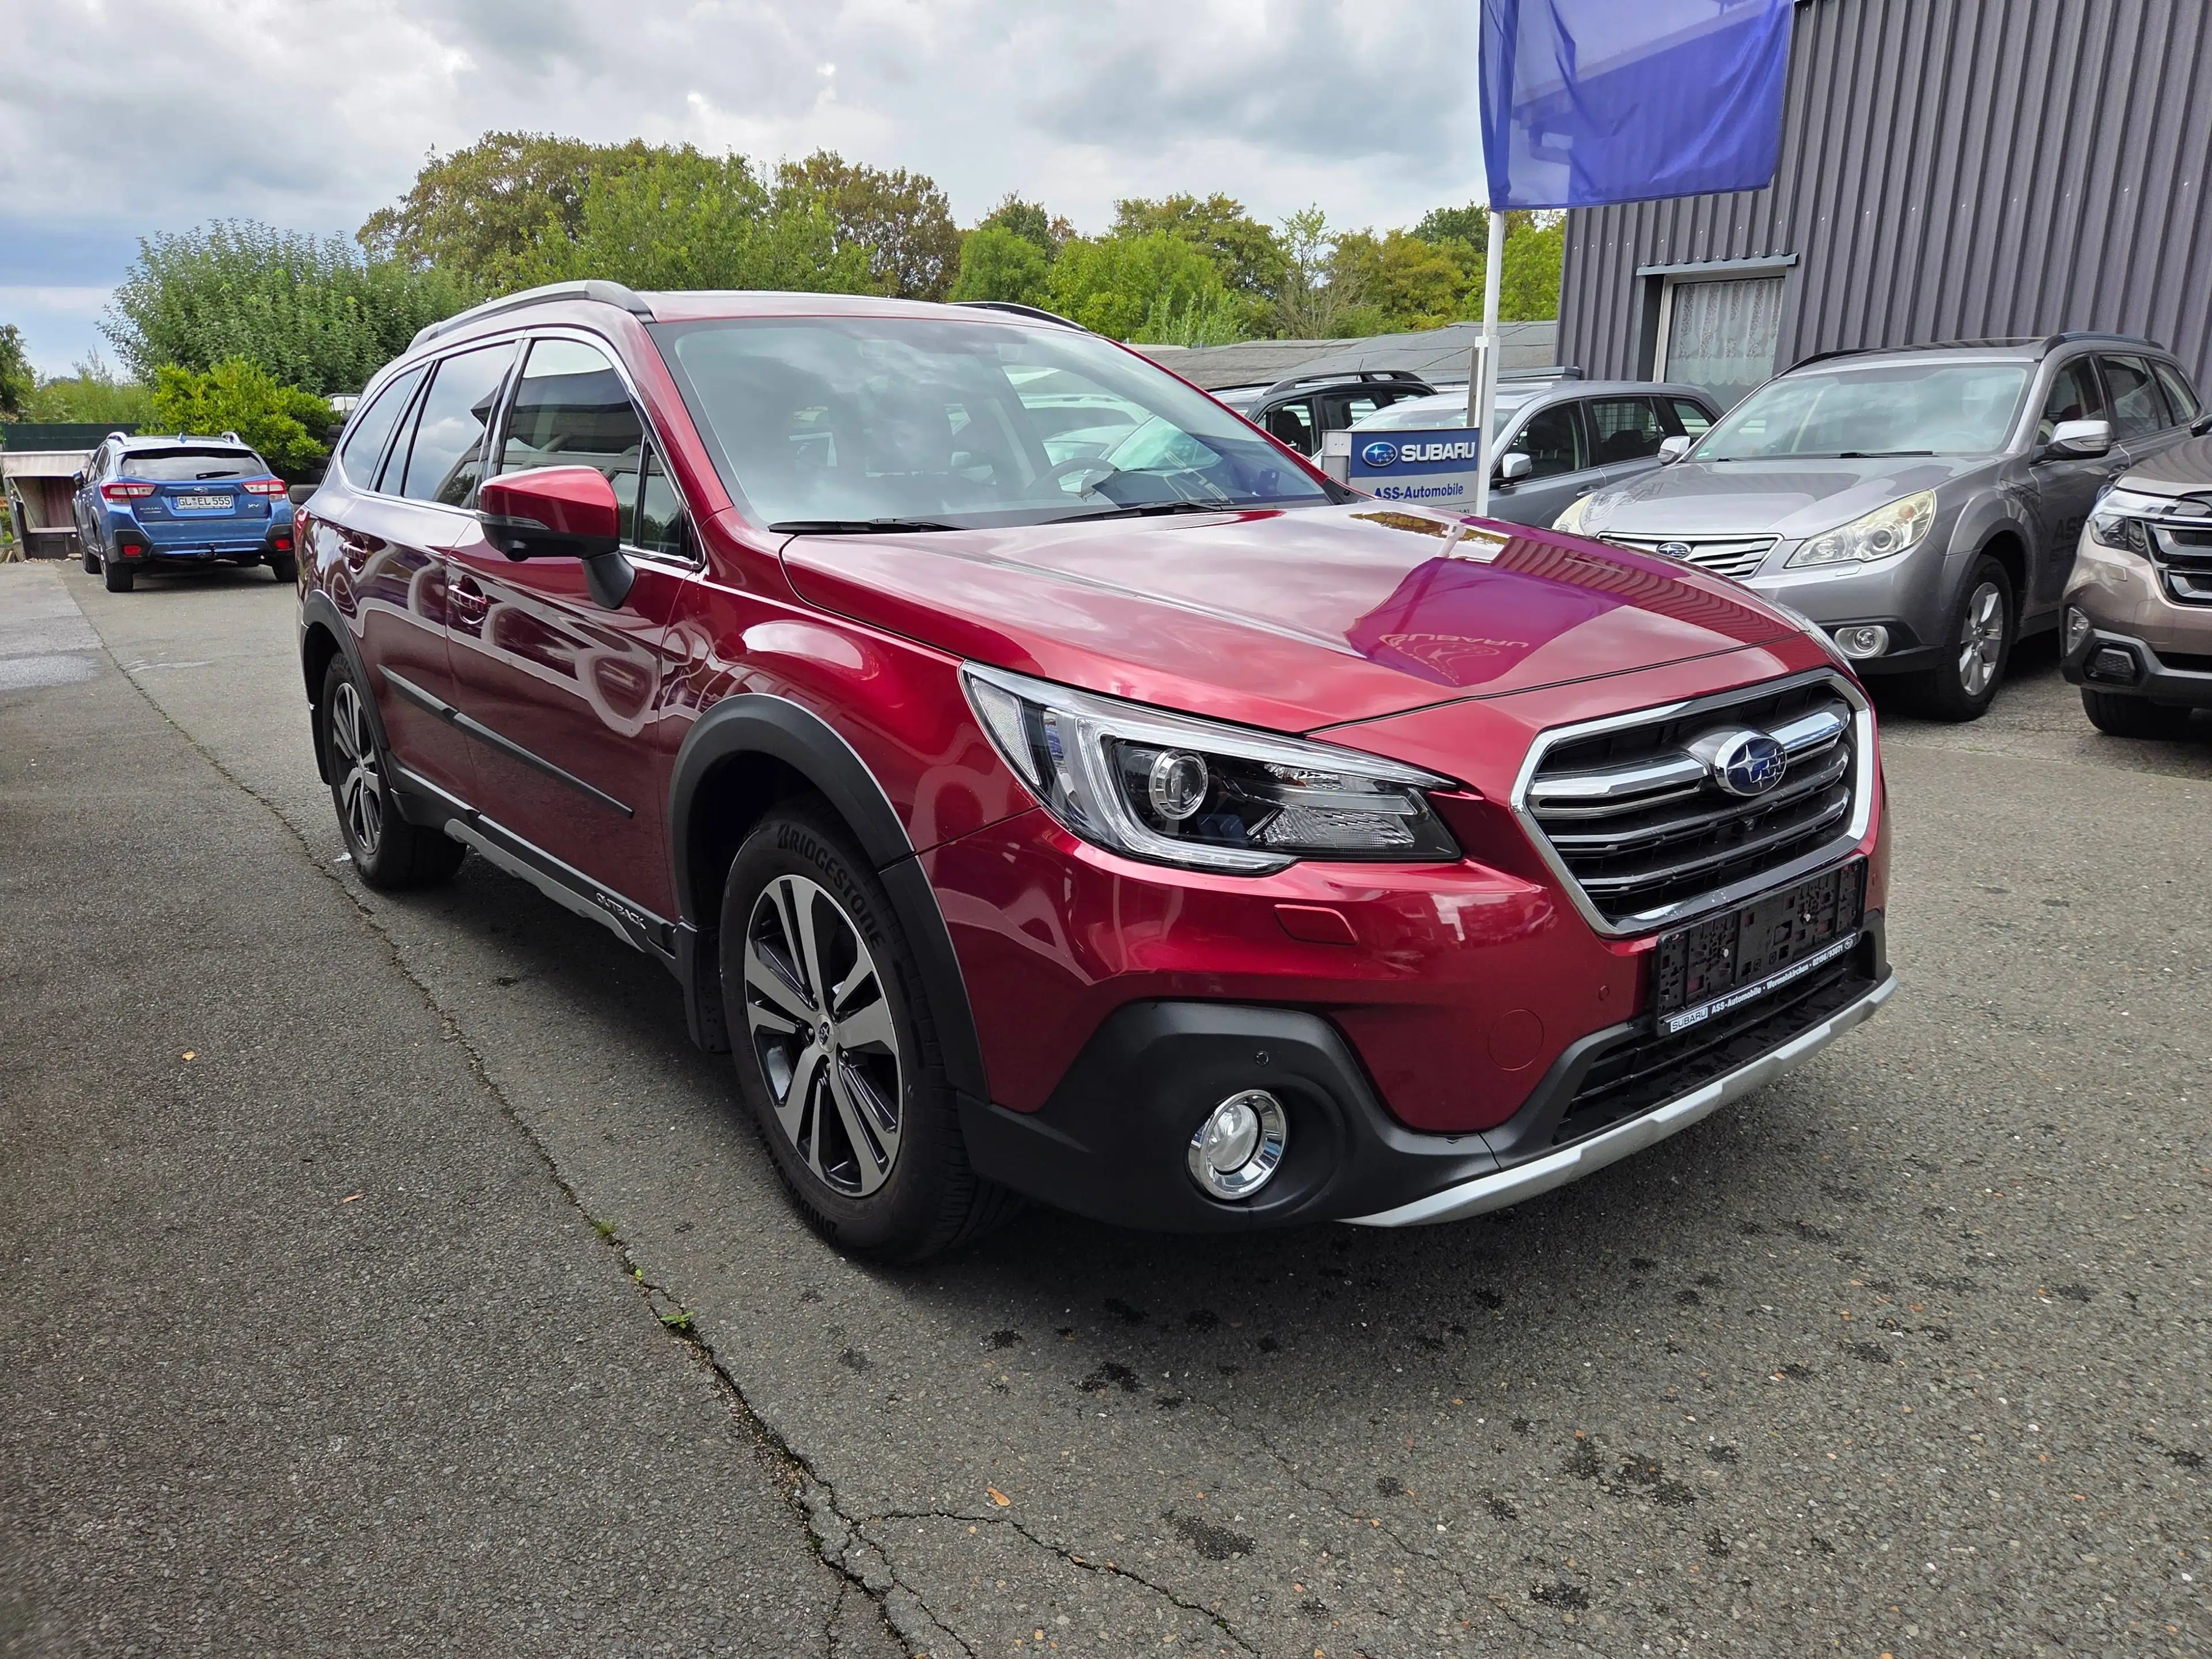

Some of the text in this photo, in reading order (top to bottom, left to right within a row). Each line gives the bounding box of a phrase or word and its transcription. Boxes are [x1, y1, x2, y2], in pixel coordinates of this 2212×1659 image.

[1401, 442, 1476, 463] SUBARU
[178, 497, 230, 506] GL EL 555
[1374, 483, 1464, 500] ASS-Automobile
[777, 824, 886, 950] BRIDGESTONE
[596, 892, 647, 930] OUTBACK
[1672, 1009, 1707, 1030] SUBARU
[1711, 986, 1762, 1014] ASS-Automobile
